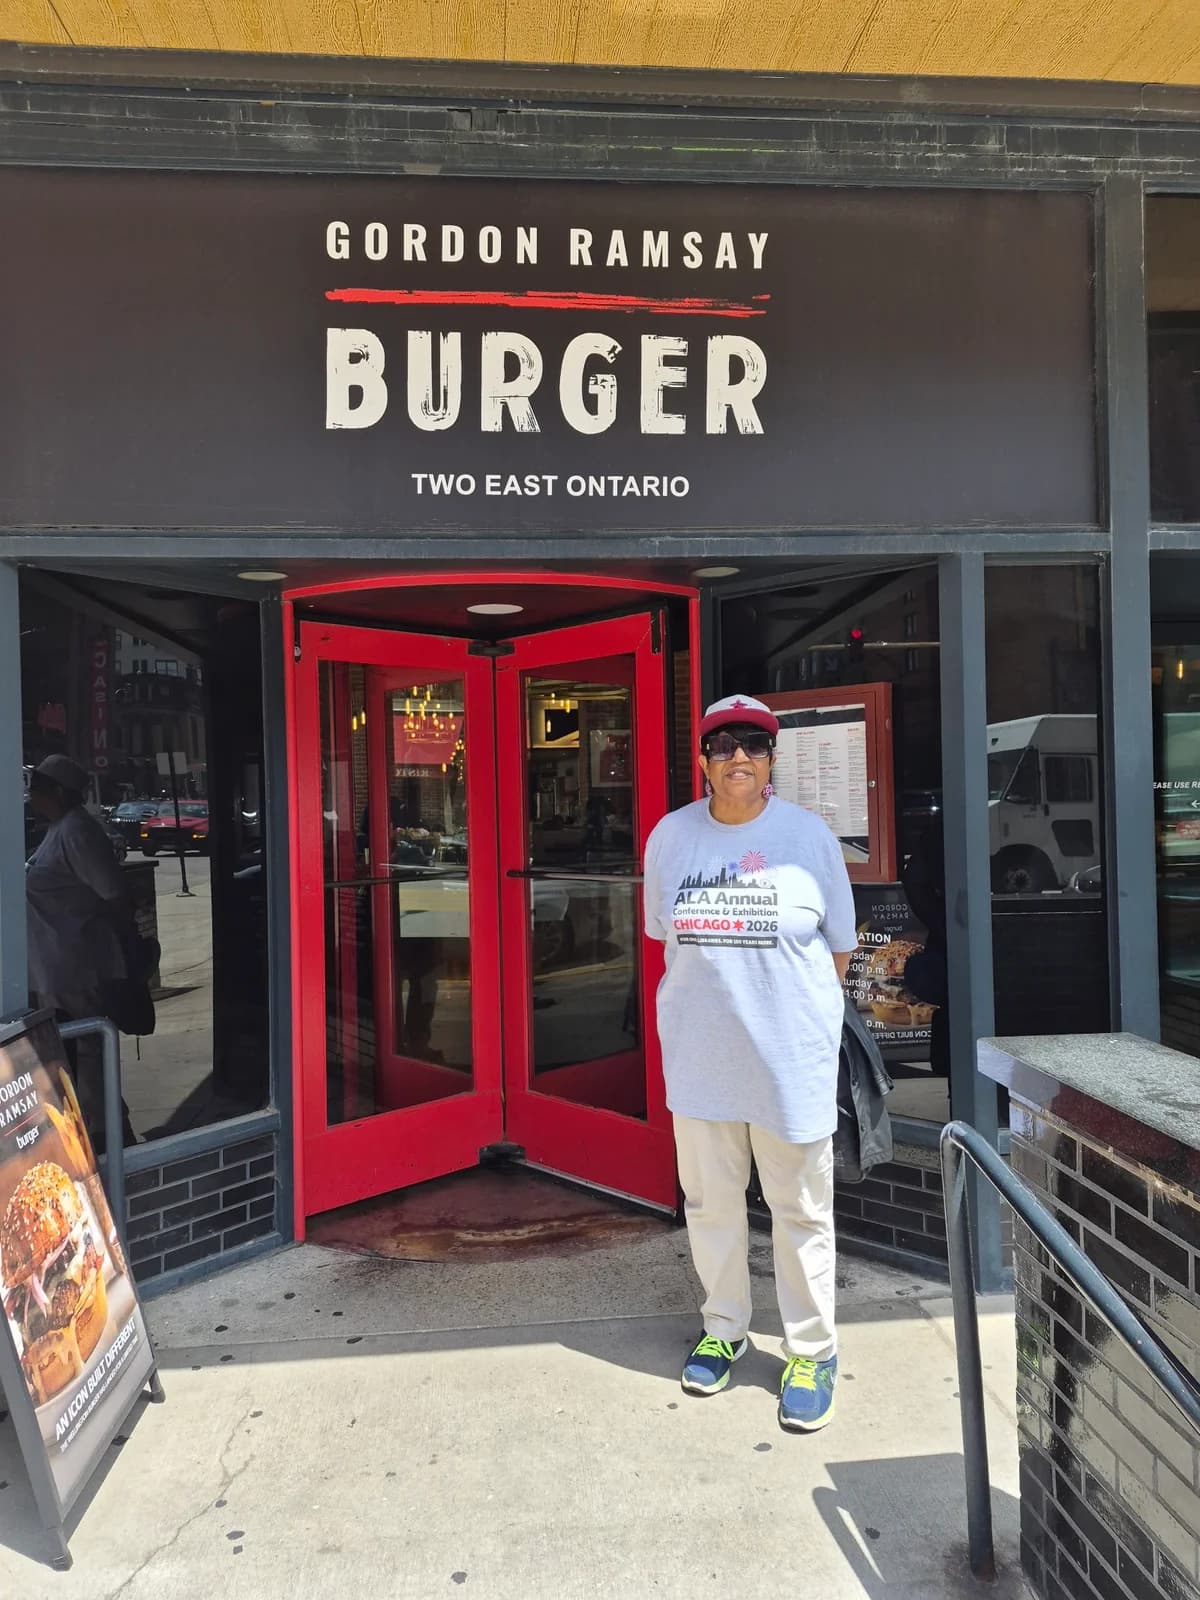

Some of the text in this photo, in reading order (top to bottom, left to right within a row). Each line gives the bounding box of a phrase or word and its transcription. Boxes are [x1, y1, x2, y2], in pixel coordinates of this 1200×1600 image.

[326, 221, 769, 269] GORDON RAMSAY
[325, 327, 768, 435] BURGER
[411, 473, 690, 498] TWO EAST ONTARIO
[1174, 781, 1191, 789] USE
[674, 891, 778, 906] ALA Annual
[673, 907, 778, 917] Conference & Exhibition
[674, 919, 778, 933] CHICAGO 2026
[855, 932, 891, 943] ATION
[0, 1072, 33, 1104] ORDON
[0, 1091, 38, 1128] RAMSAY
[16, 1125, 39, 1149] burger
[55, 1316, 136, 1441] AN ICON BUILT DIFFERENT
